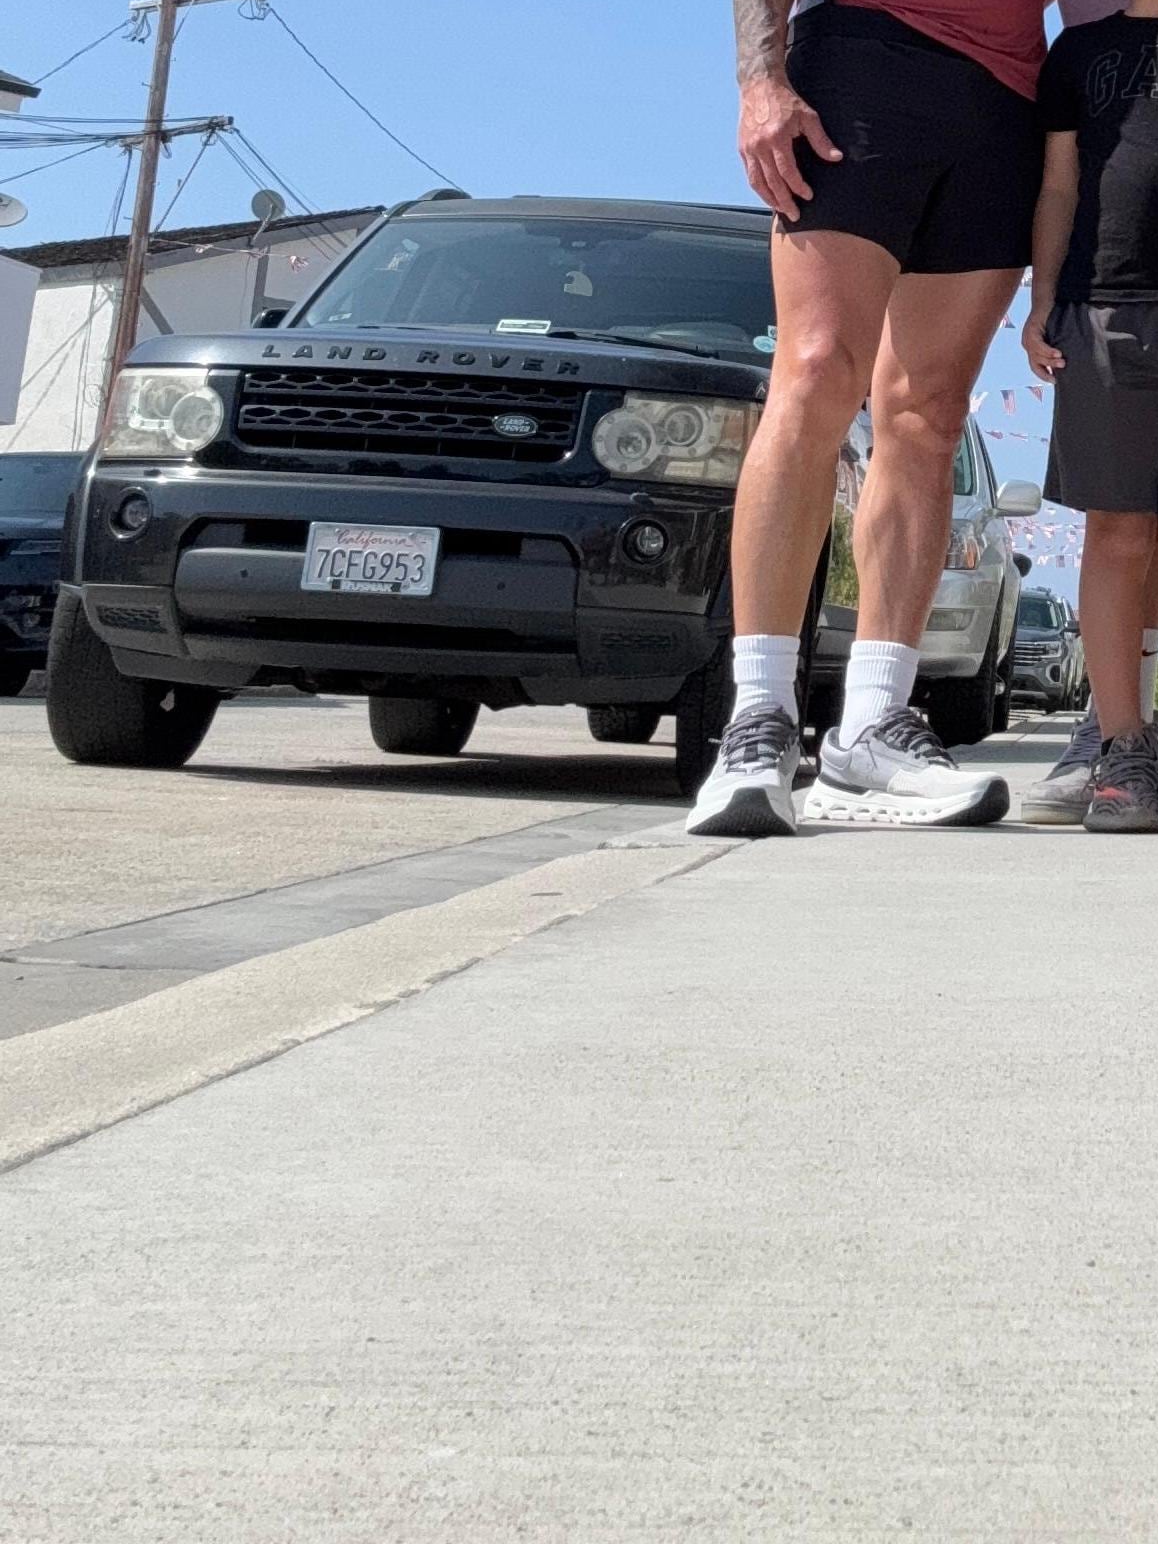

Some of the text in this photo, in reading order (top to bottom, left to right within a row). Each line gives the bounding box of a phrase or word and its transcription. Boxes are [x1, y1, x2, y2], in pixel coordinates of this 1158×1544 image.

[261, 344, 580, 375] LAND ROVER
[335, 529, 413, 548] California
[316, 548, 426, 583] 7CFG953
